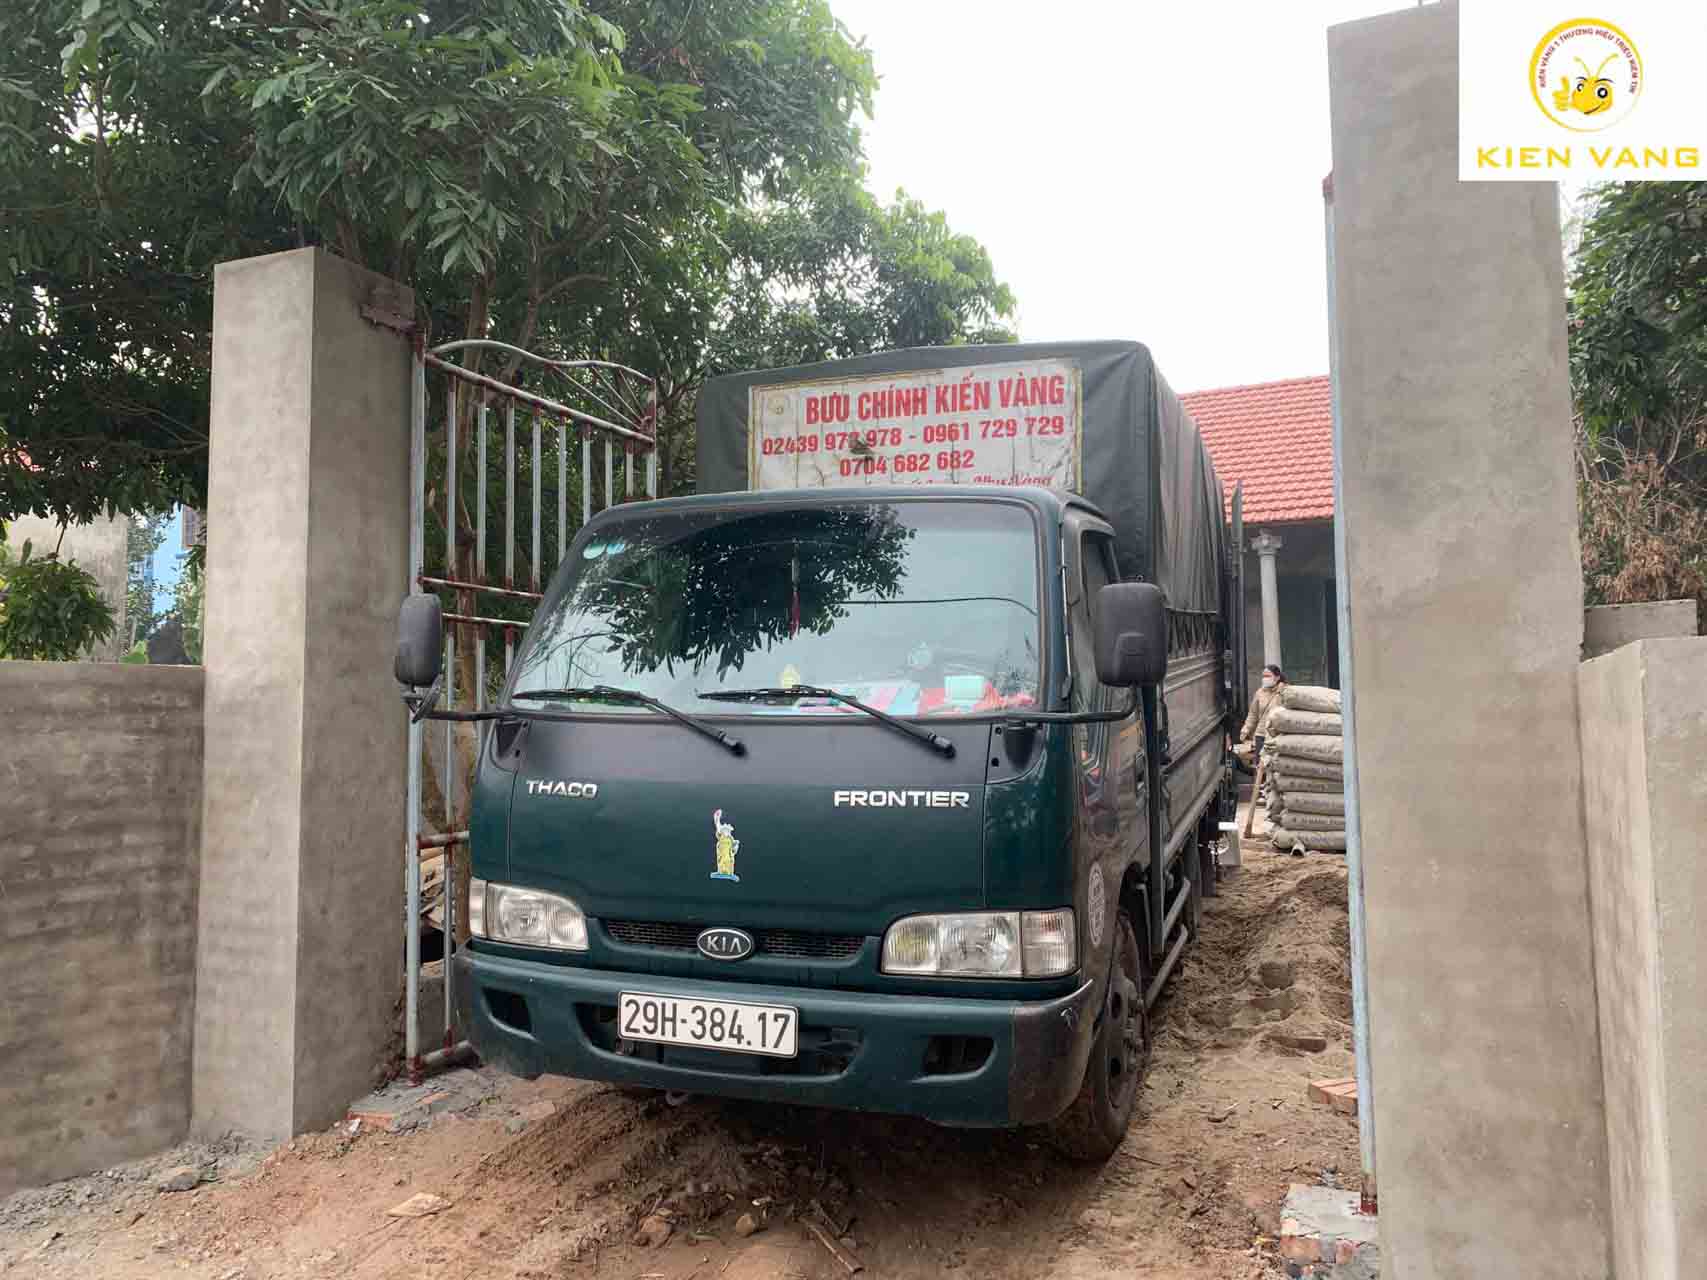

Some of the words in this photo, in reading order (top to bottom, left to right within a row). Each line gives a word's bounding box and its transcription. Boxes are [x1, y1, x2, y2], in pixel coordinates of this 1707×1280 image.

[857, 384, 928, 421] CHÍNH
[934, 371, 991, 415] KIẾN
[997, 371, 1065, 409] VÀNG
[761, 434, 819, 456] 02439
[865, 427, 902, 449] 978
[922, 422, 970, 444] 0961
[978, 418, 1018, 440] 729
[1024, 415, 1065, 436] 729
[893, 453, 931, 473] 682
[936, 449, 976, 471] 682
[526, 779, 599, 800] THACO
[833, 790, 970, 809] FRONTIER
[706, 935, 743, 953] KIA
[624, 998, 791, 1050] 29H-384.17
